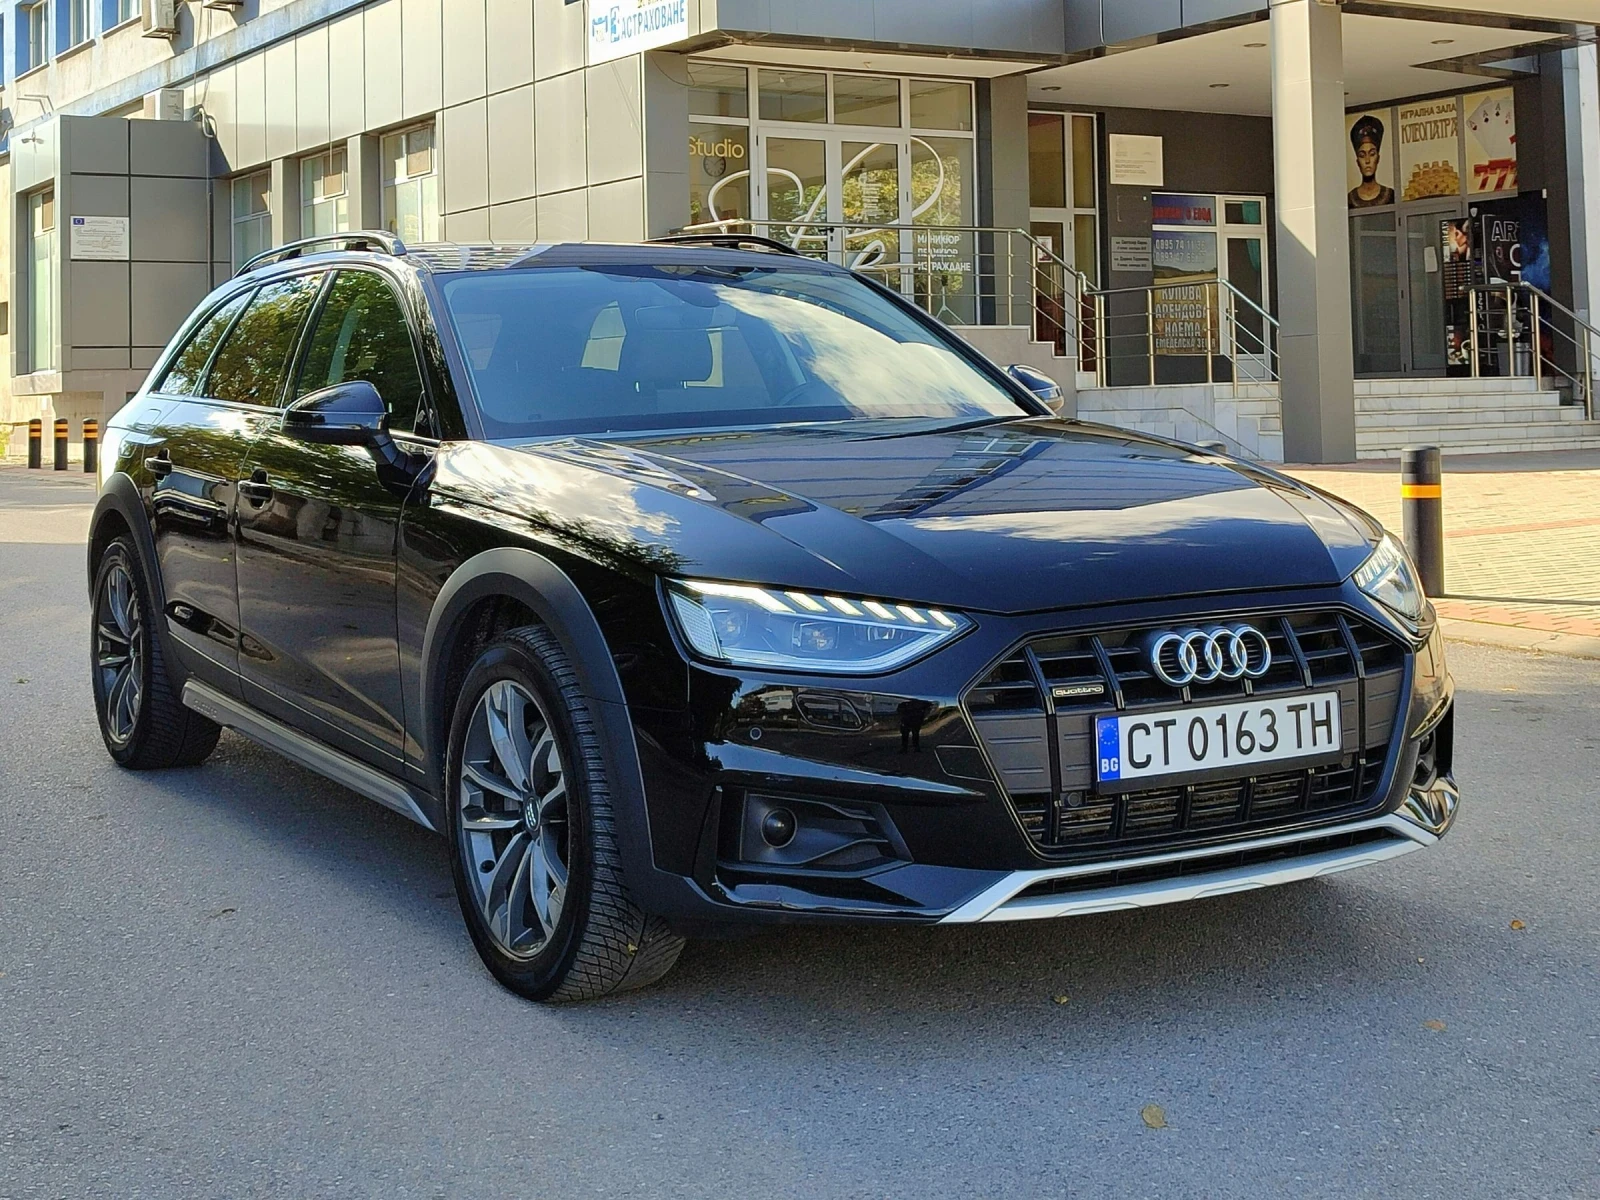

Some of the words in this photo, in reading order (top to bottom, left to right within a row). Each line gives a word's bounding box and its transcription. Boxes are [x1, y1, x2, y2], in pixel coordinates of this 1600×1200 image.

[1400, 106, 1435, 120] ИГРАЛНА
[1436, 103, 1457, 115] ЗАЛА
[1401, 116, 1459, 144] КЛЕОПАТРА
[688, 136, 745, 158] Studio
[1162, 286, 1202, 300] КУПУВА
[1196, 338, 1216, 348] ЗЕЯ
[1055, 687, 1102, 697] quattro
[1127, 718, 1177, 769] CT
[1187, 708, 1279, 761] 0163
[1286, 700, 1333, 749] TH
[1101, 757, 1119, 773] BG
